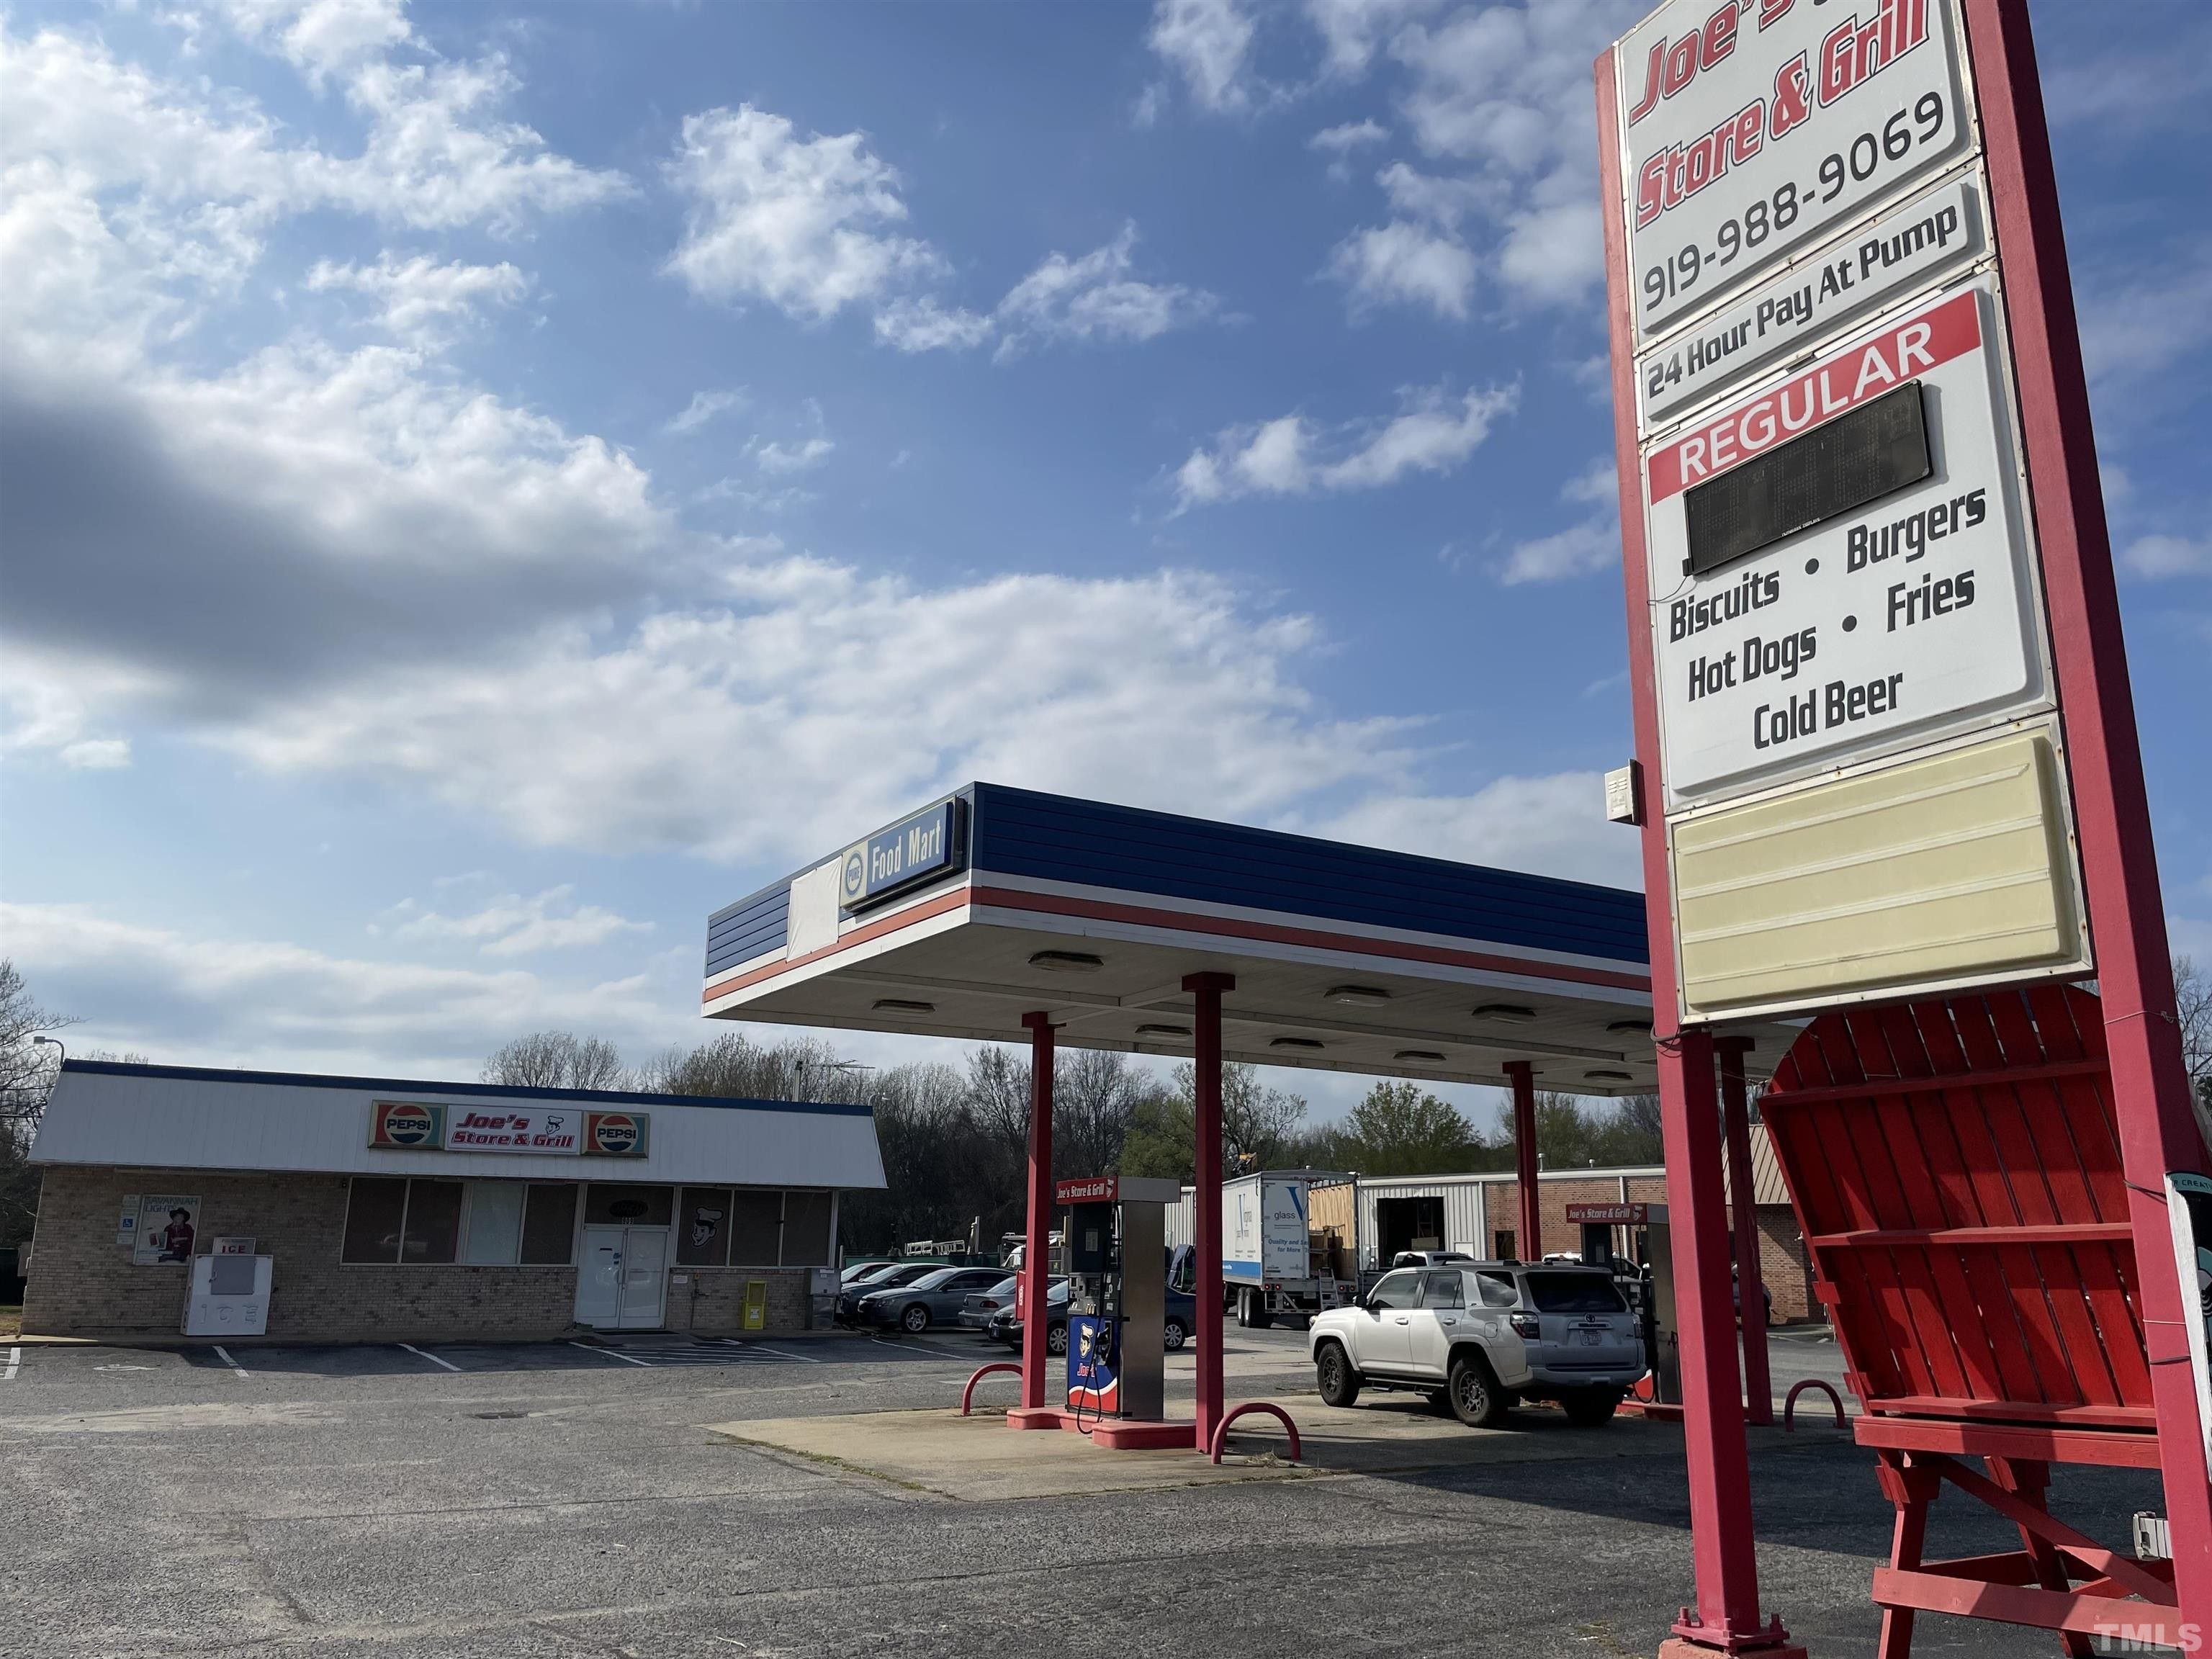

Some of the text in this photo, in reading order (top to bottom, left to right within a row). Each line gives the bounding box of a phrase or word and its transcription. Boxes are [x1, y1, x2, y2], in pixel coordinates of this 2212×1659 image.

[1635, 0, 1930, 233] Store & Grill
[1644, 91, 1943, 312] 919-988-9069
[1647, 204, 1957, 398] 24 Hour Pay At Pump
[1679, 321, 1936, 486] REGULAR
[1669, 487, 1987, 644] Biscuits Burgers
[1688, 569, 1975, 703] Hot Dogs Fries
[1753, 672, 1903, 750] Cold Beer
[871, 819, 941, 884] Food Mart
[386, 1118, 431, 1130] PEPSI
[451, 1130, 575, 1148] Store & Grill
[455, 1112, 531, 1130] Joe's
[597, 1128, 637, 1139] PEPSI
[145, 1197, 198, 1205] SAVANNAH
[1057, 1183, 1105, 1199] Joe's Store & Grill
[1274, 1210, 1296, 1220] glass
[1568, 1208, 1630, 1218] Joe's Store & Grill
